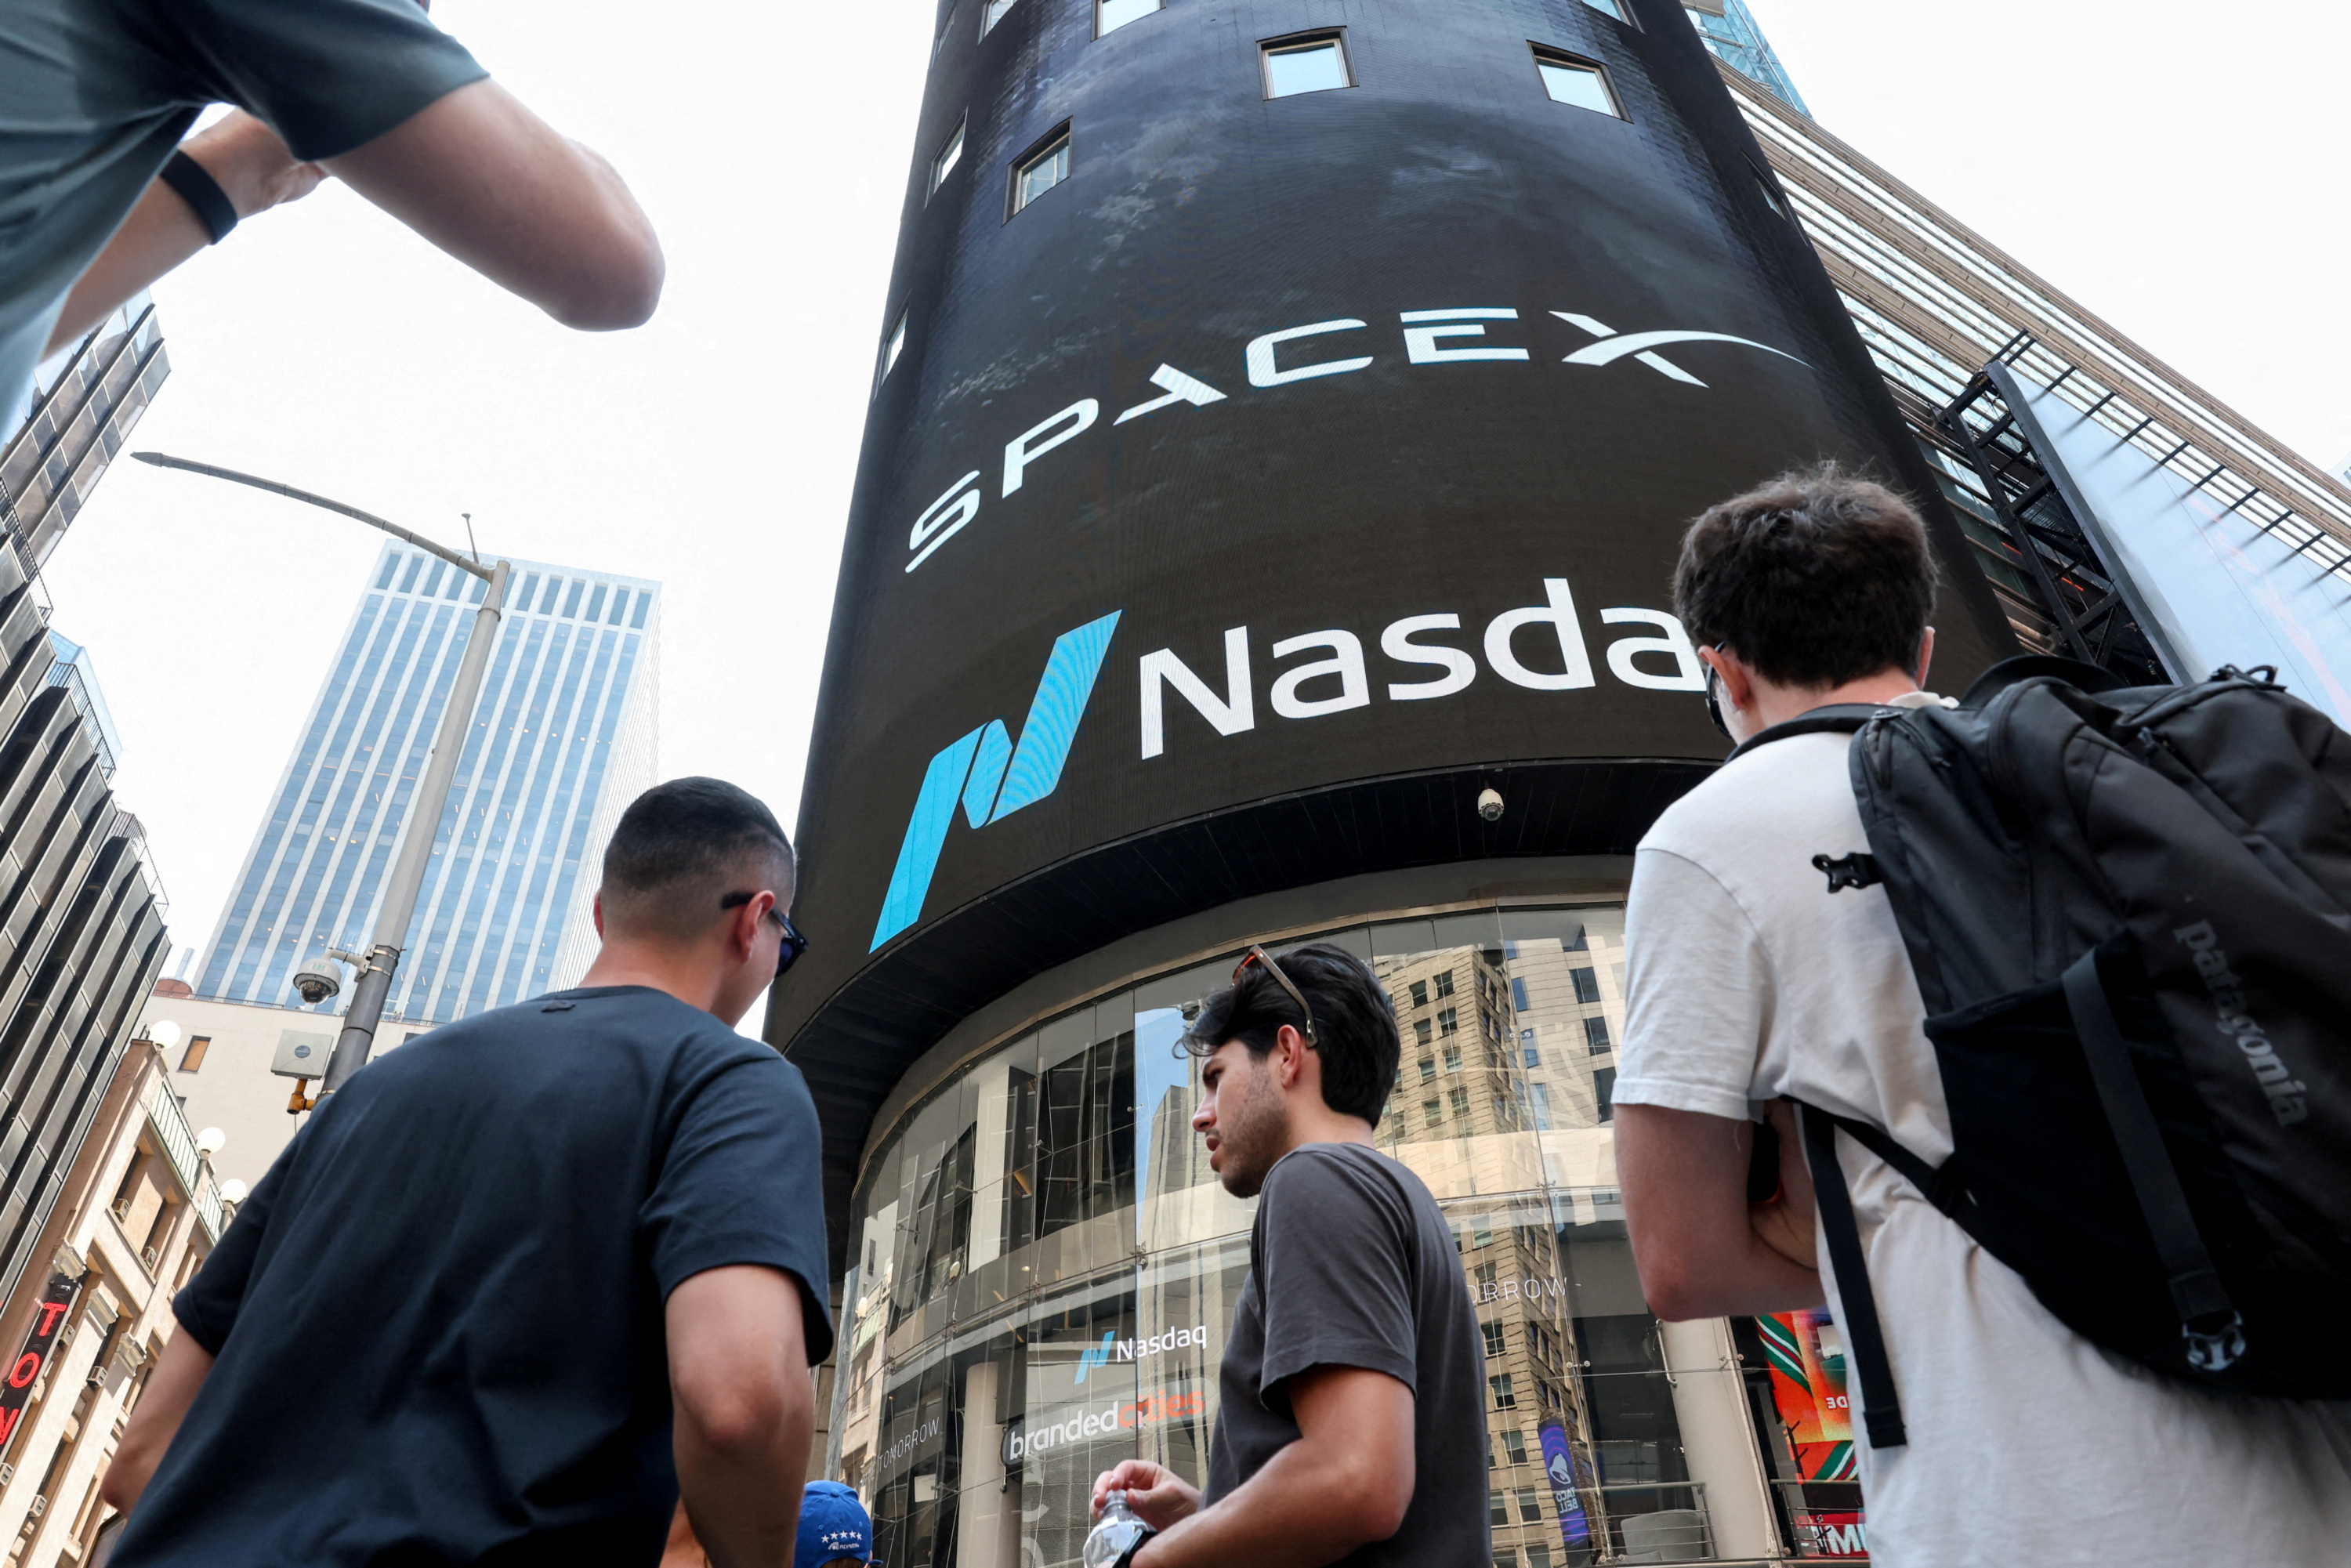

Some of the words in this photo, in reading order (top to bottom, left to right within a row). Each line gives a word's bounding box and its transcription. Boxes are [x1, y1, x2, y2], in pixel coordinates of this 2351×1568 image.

[904, 307, 1814, 574] SPACEX
[1139, 578, 1708, 760] Nasda
[2174, 919, 2307, 1127] patagonia
[1117, 1325, 1208, 1363] Nasdaq
[1466, 1276, 1567, 1304] ORROW
[878, 1416, 940, 1472] TOMORROW
